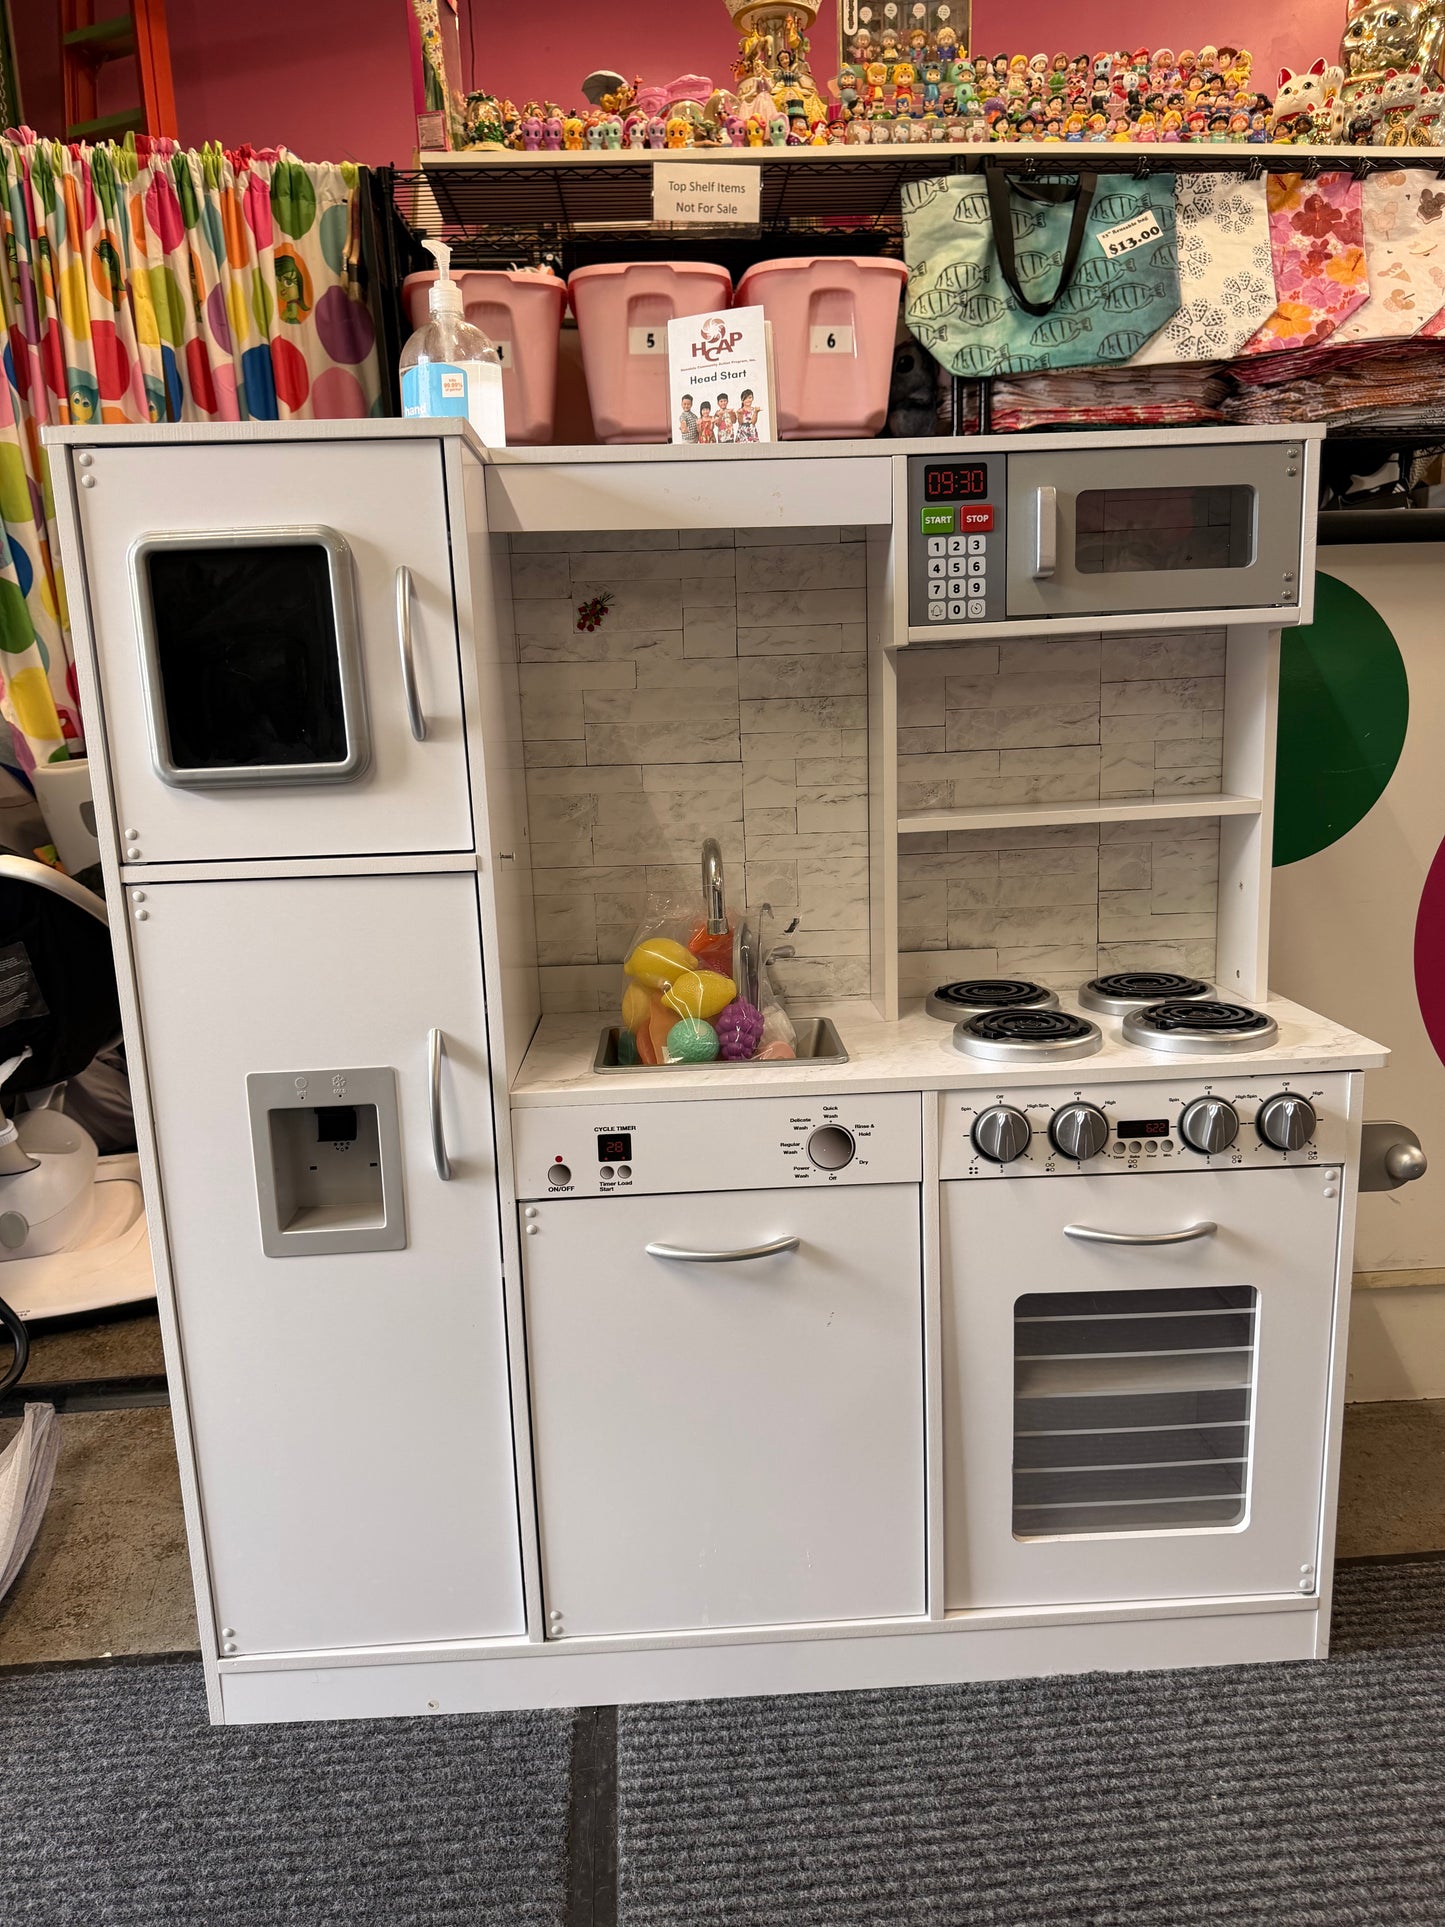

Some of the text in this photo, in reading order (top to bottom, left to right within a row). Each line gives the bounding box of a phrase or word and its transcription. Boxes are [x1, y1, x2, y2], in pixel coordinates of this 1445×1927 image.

[668, 181, 746, 194] Top Shelf Items
[676, 202, 738, 214] Not For Sale
[1108, 226, 1160, 255] $13.00
[646, 333, 655, 348] 5
[827, 333, 836, 348] 6
[691, 331, 743, 362] HCAP
[690, 369, 747, 385] Head Start
[404, 404, 427, 417] hand
[927, 469, 984, 495] 09:30
[925, 515, 952, 525] START
[966, 514, 989, 523] STOP
[933, 542, 940, 552] 1
[953, 541, 960, 551] 2
[973, 540, 980, 550] 3
[933, 564, 940, 573] 4
[953, 563, 960, 572] 5
[973, 562, 980, 571] 6
[933, 585, 940, 594] 7
[953, 584, 960, 593] 8
[973, 583, 980, 592] 9
[953, 605, 960, 614] 0
[606, 1141, 623, 1153] 28
